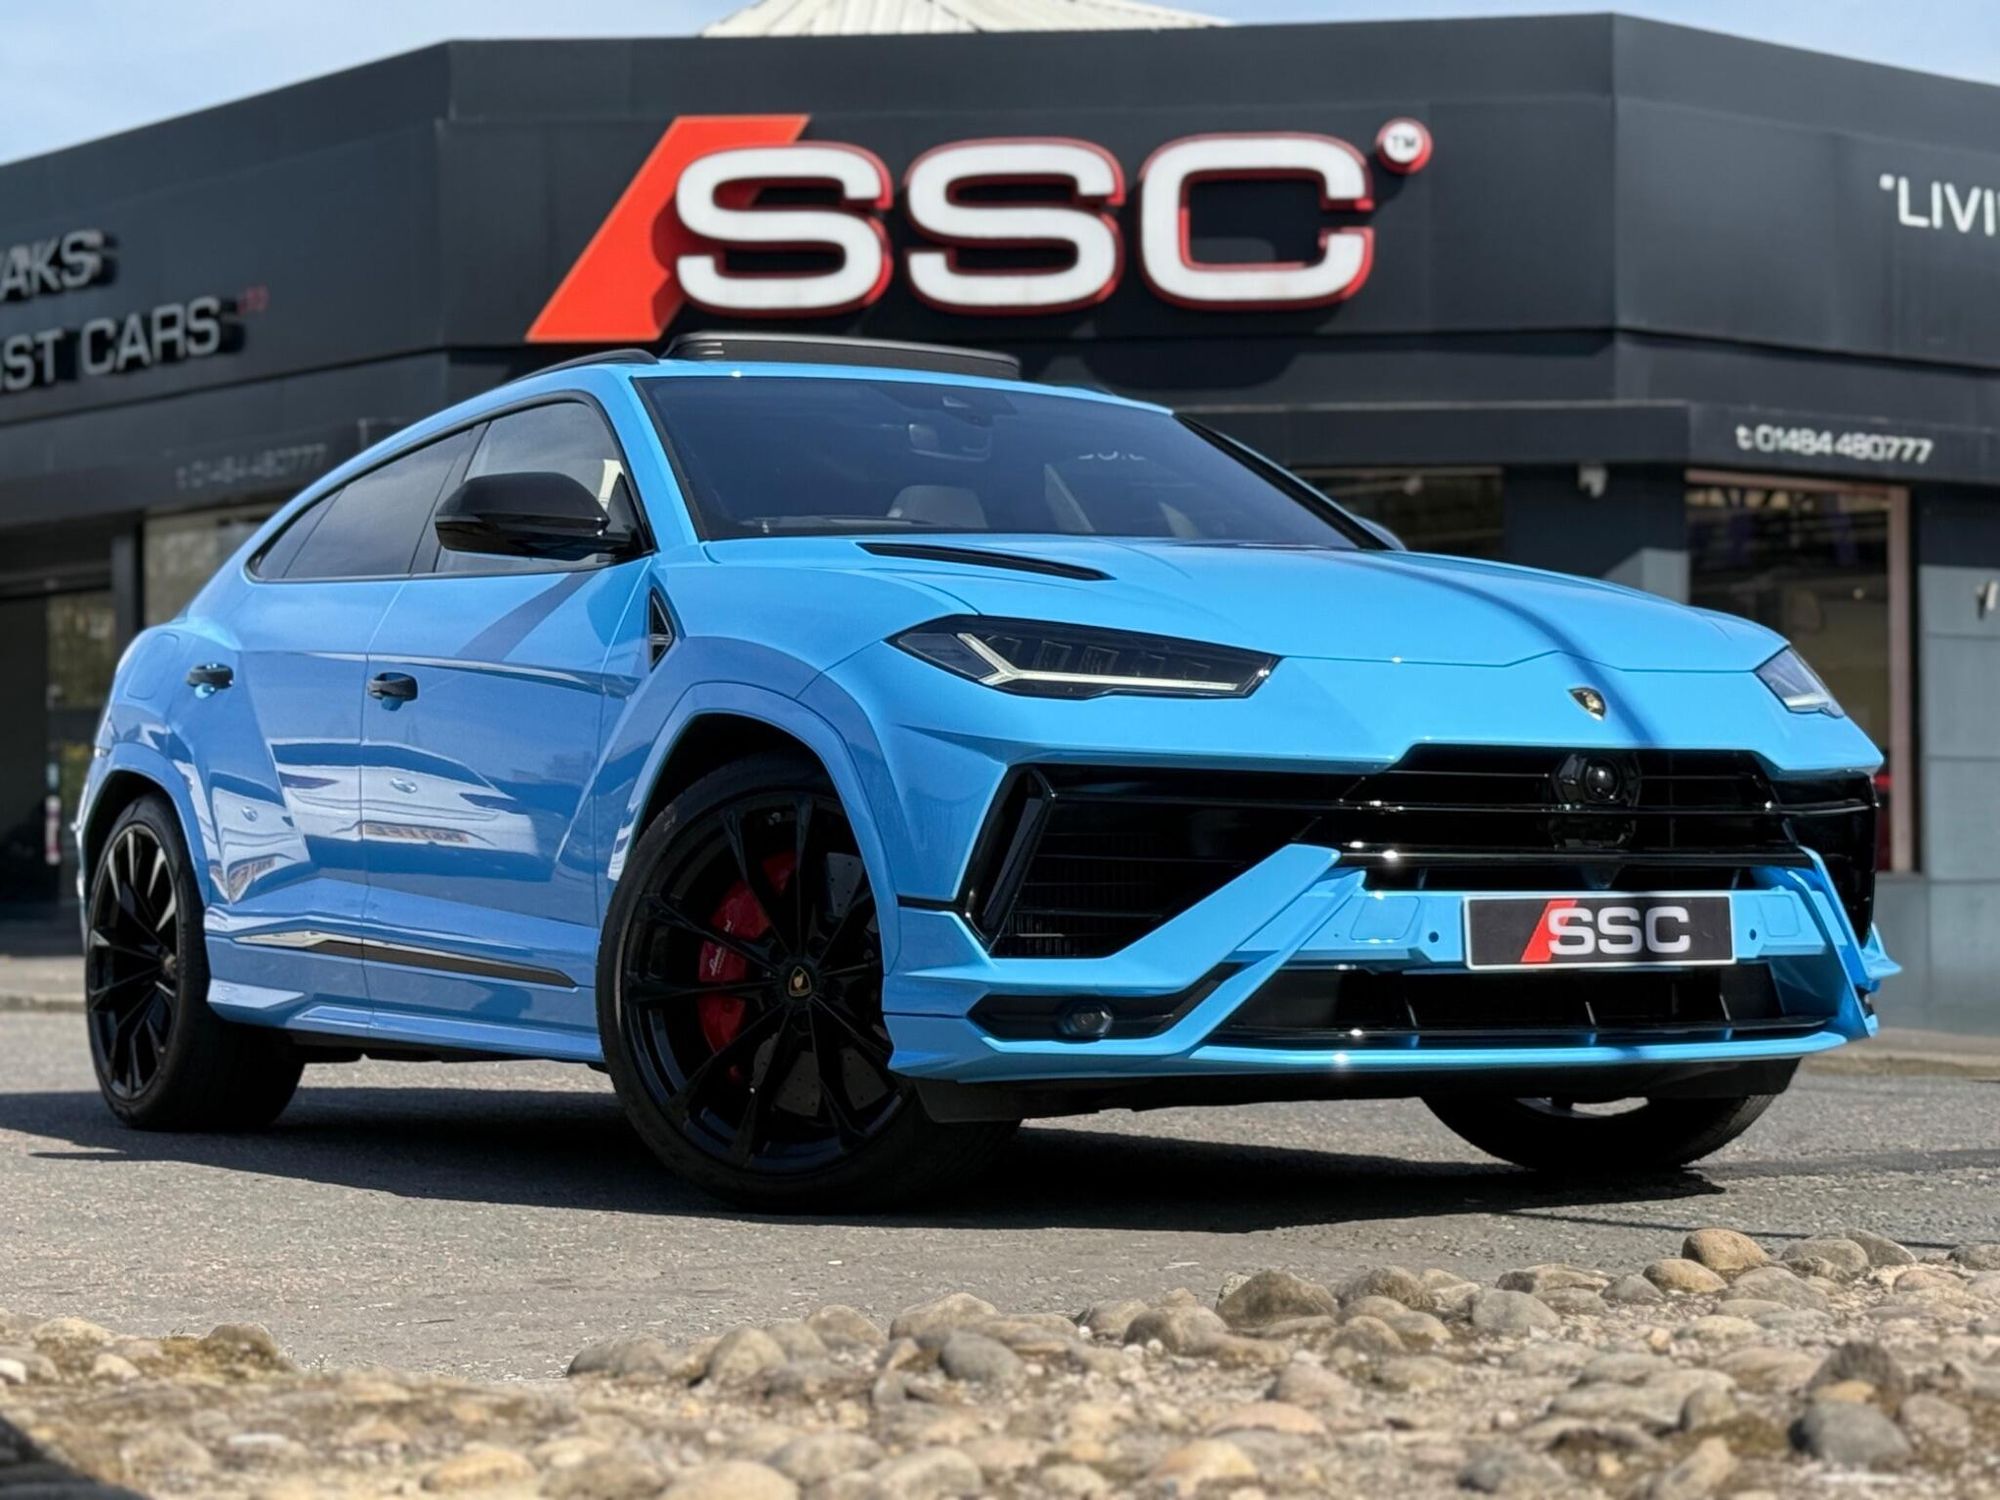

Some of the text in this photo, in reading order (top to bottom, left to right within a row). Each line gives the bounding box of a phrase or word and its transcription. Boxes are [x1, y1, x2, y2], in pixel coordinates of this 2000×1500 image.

[676, 132, 1373, 314] SSC
[0, 230, 102, 300] AKS
[0, 296, 221, 391] ST CARS
[1547, 906, 1692, 954] SSC
